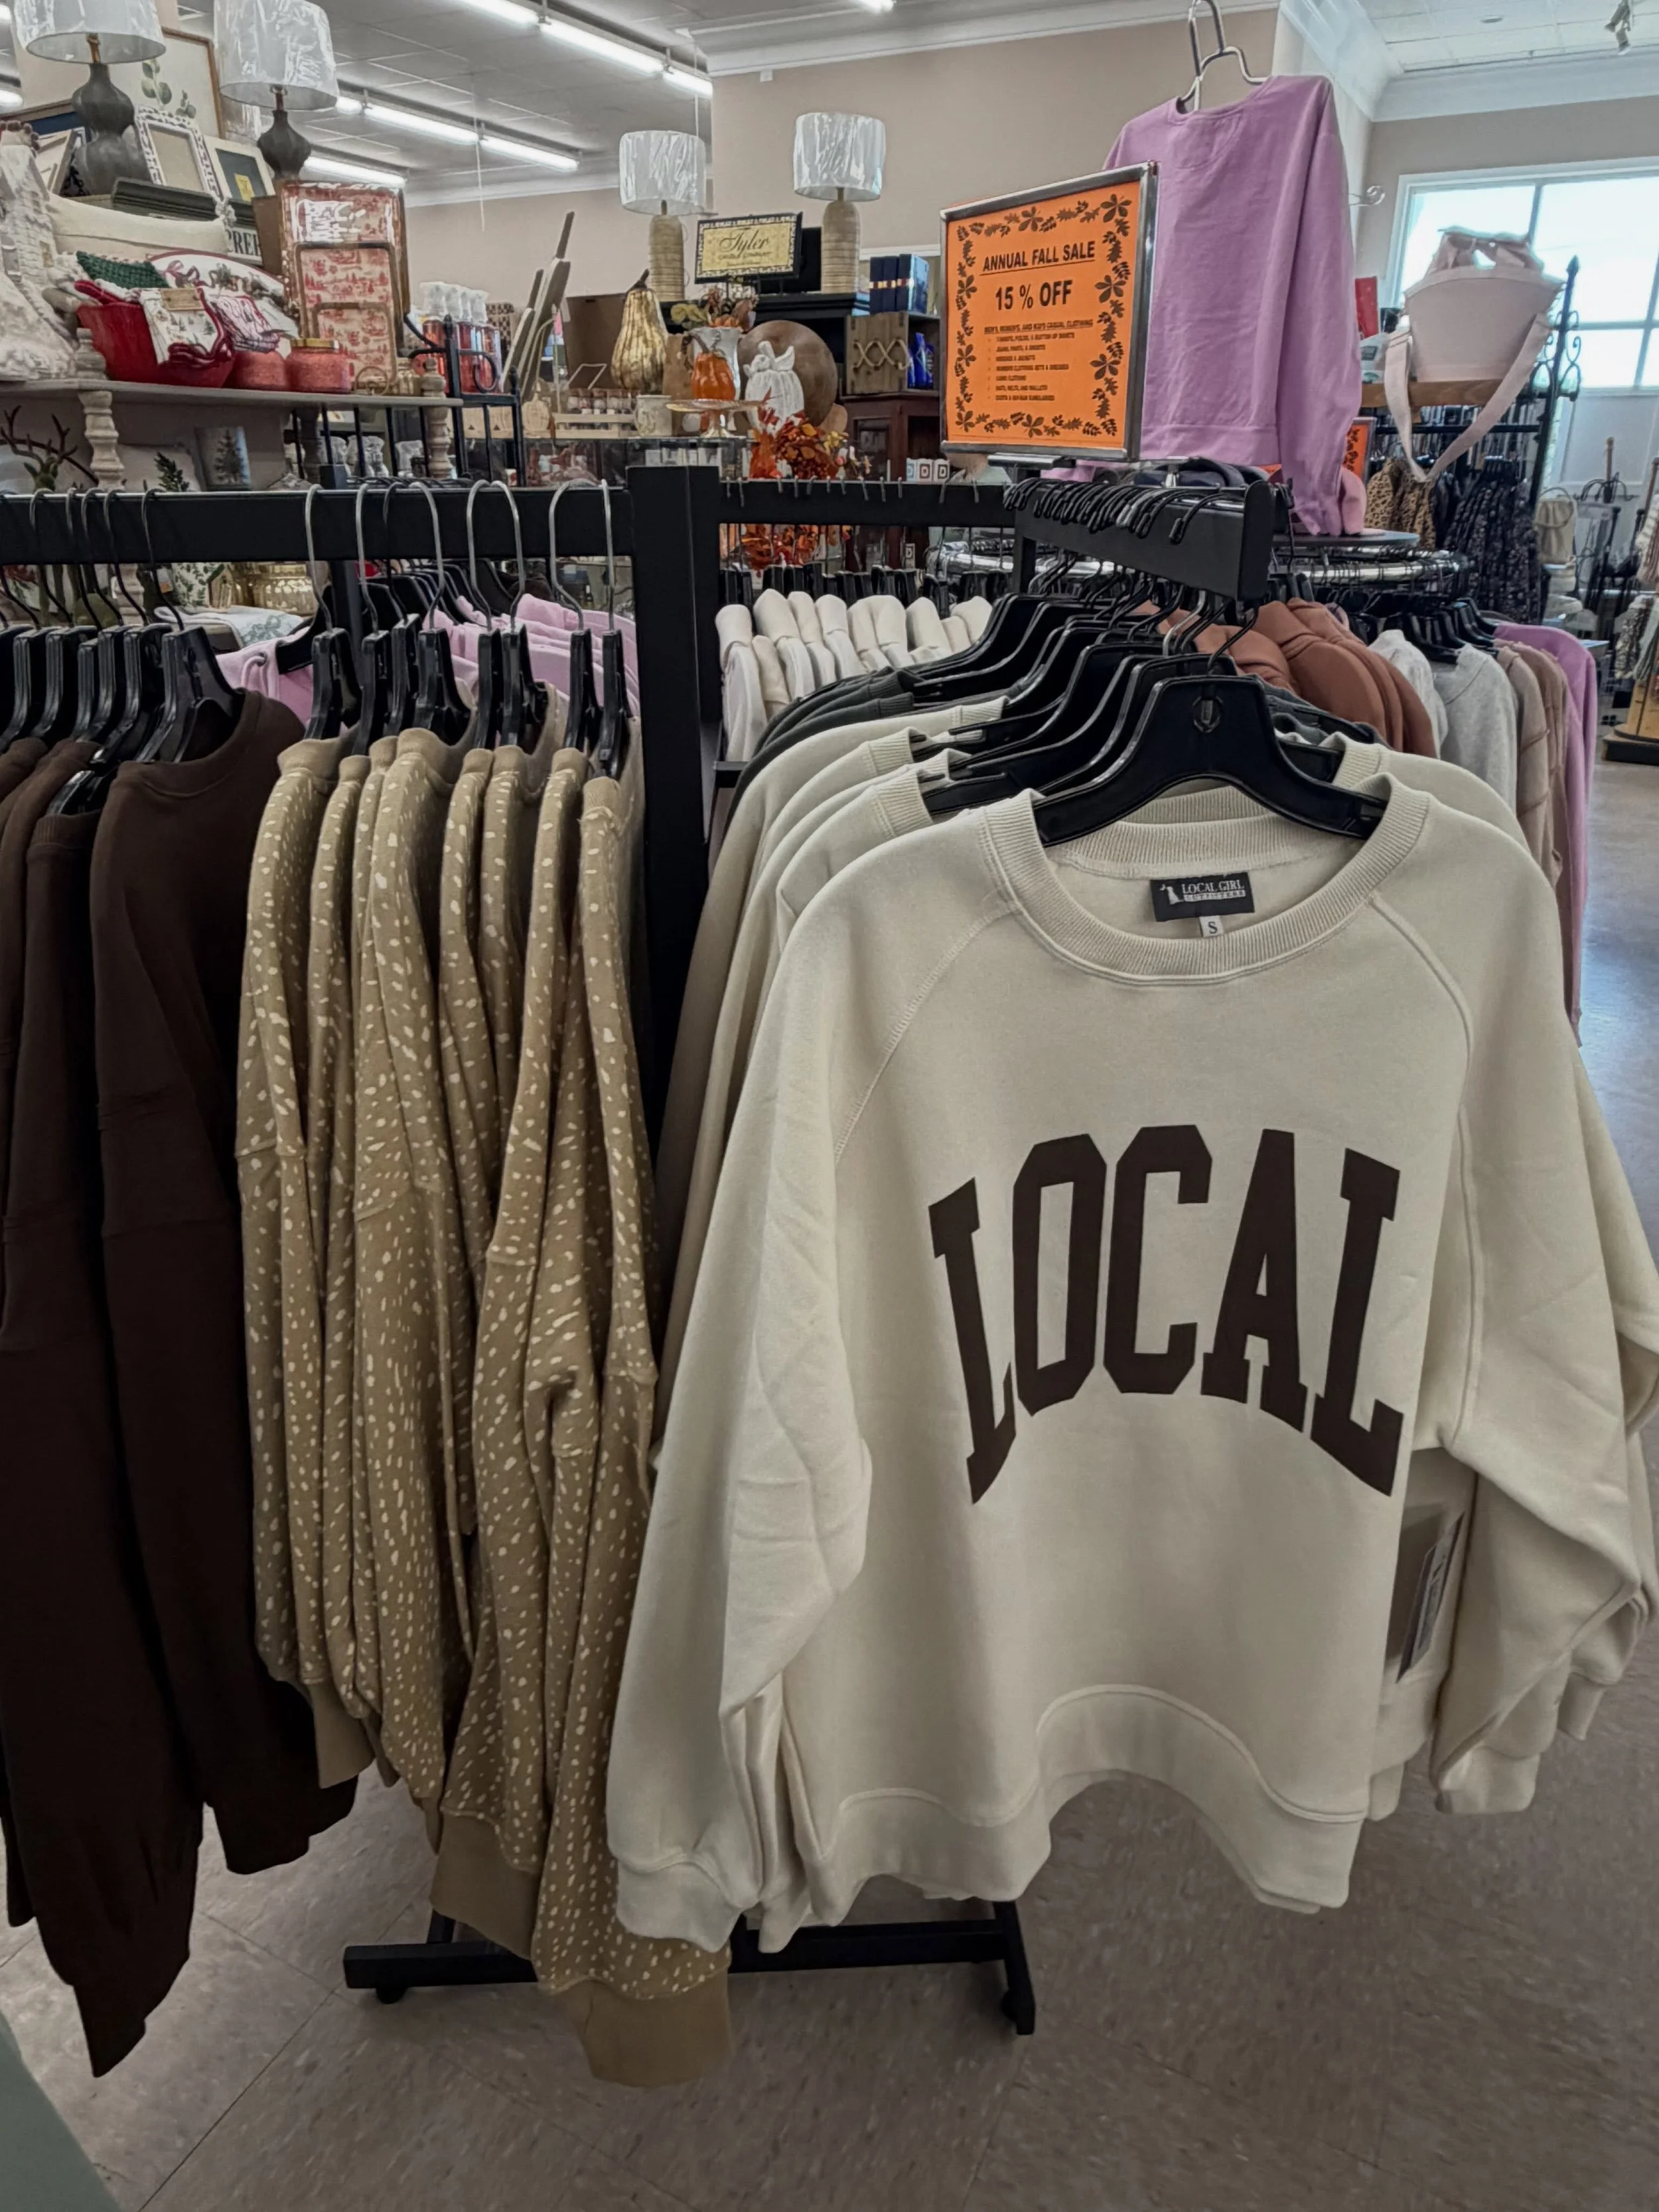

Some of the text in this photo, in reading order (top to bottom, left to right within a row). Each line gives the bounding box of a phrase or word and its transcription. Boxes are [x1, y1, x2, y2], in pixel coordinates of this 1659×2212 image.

[719, 227, 770, 257] Tyler
[983, 241, 1095, 271] ANNUAL FALL SALE
[995, 279, 1073, 311] 15 % OFF
[1181, 879, 1245, 894] LOCAL GIRL
[1208, 921, 1218, 934] S
[928, 1124, 1404, 1505] LOCAL
